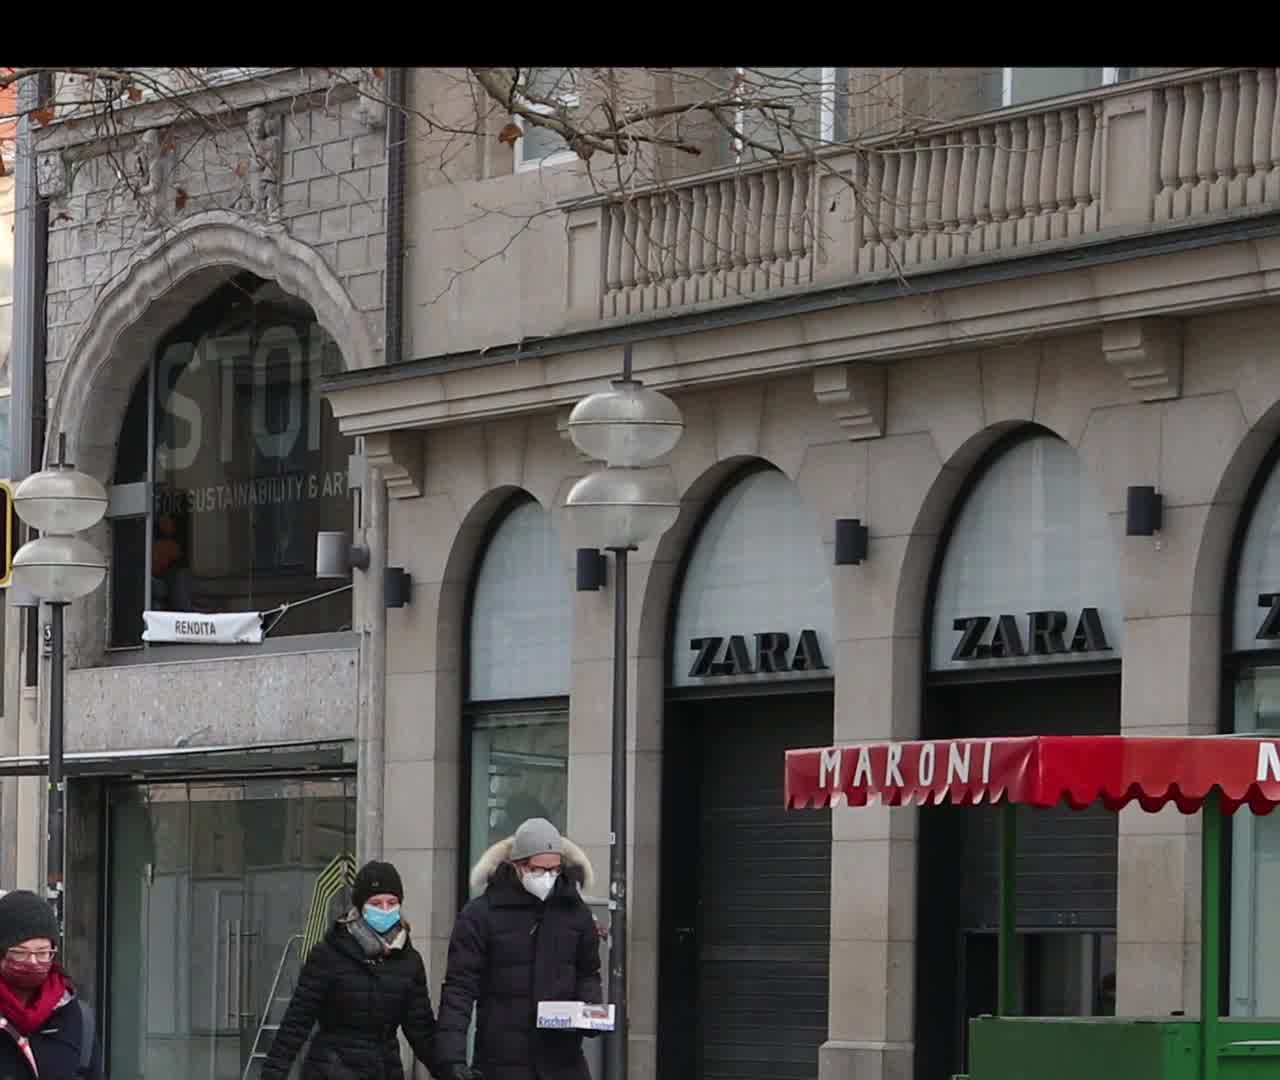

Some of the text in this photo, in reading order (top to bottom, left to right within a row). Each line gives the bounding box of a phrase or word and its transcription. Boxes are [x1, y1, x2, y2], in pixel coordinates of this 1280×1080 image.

[188, 474, 305, 512] SUSTAINABILITY
[175, 620, 216, 636] RENDITA
[951, 607, 1113, 661] ZARA
[688, 629, 829, 678] ZARA
[819, 741, 992, 788] MARONI
